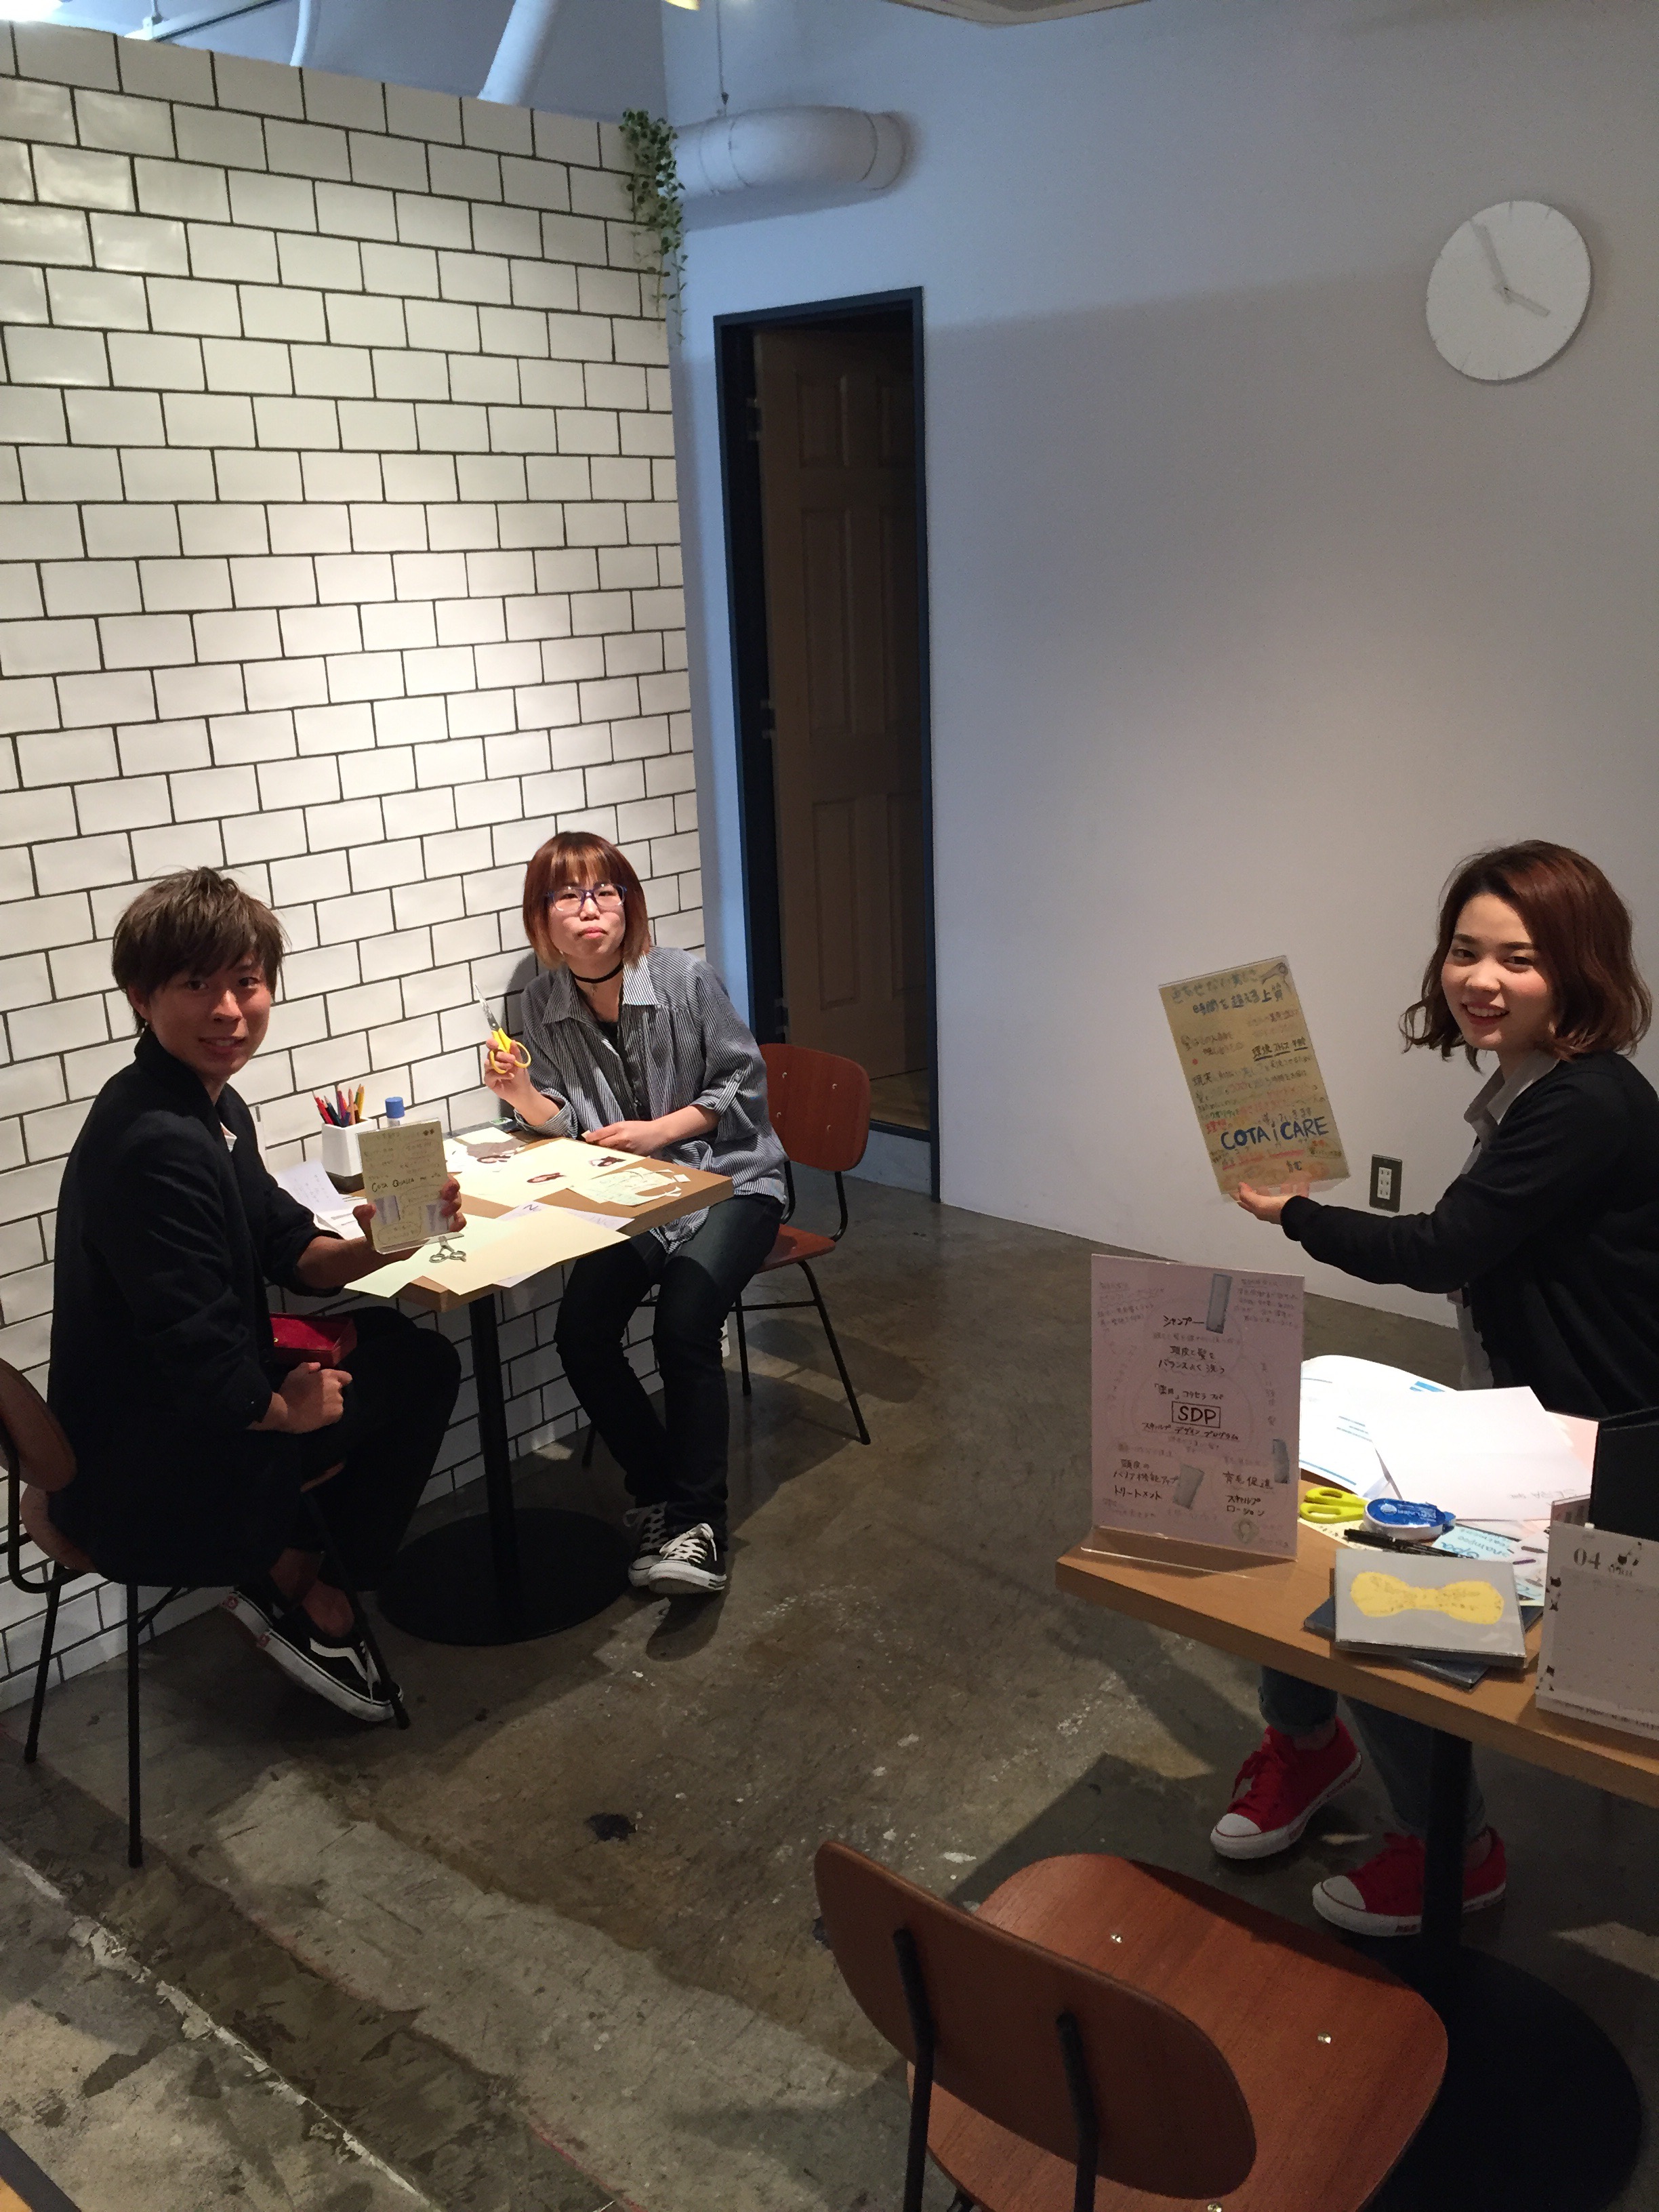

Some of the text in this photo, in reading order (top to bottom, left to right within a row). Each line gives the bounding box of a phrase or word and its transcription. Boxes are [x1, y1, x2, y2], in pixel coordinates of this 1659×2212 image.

[1221, 1126, 1271, 1150] COTA
[1280, 1117, 1329, 1140] CARE
[1163, 1315, 1205, 1328] シャンプー
[1177, 1406, 1217, 1425] SDP
[1574, 1548, 1601, 1570] 04
